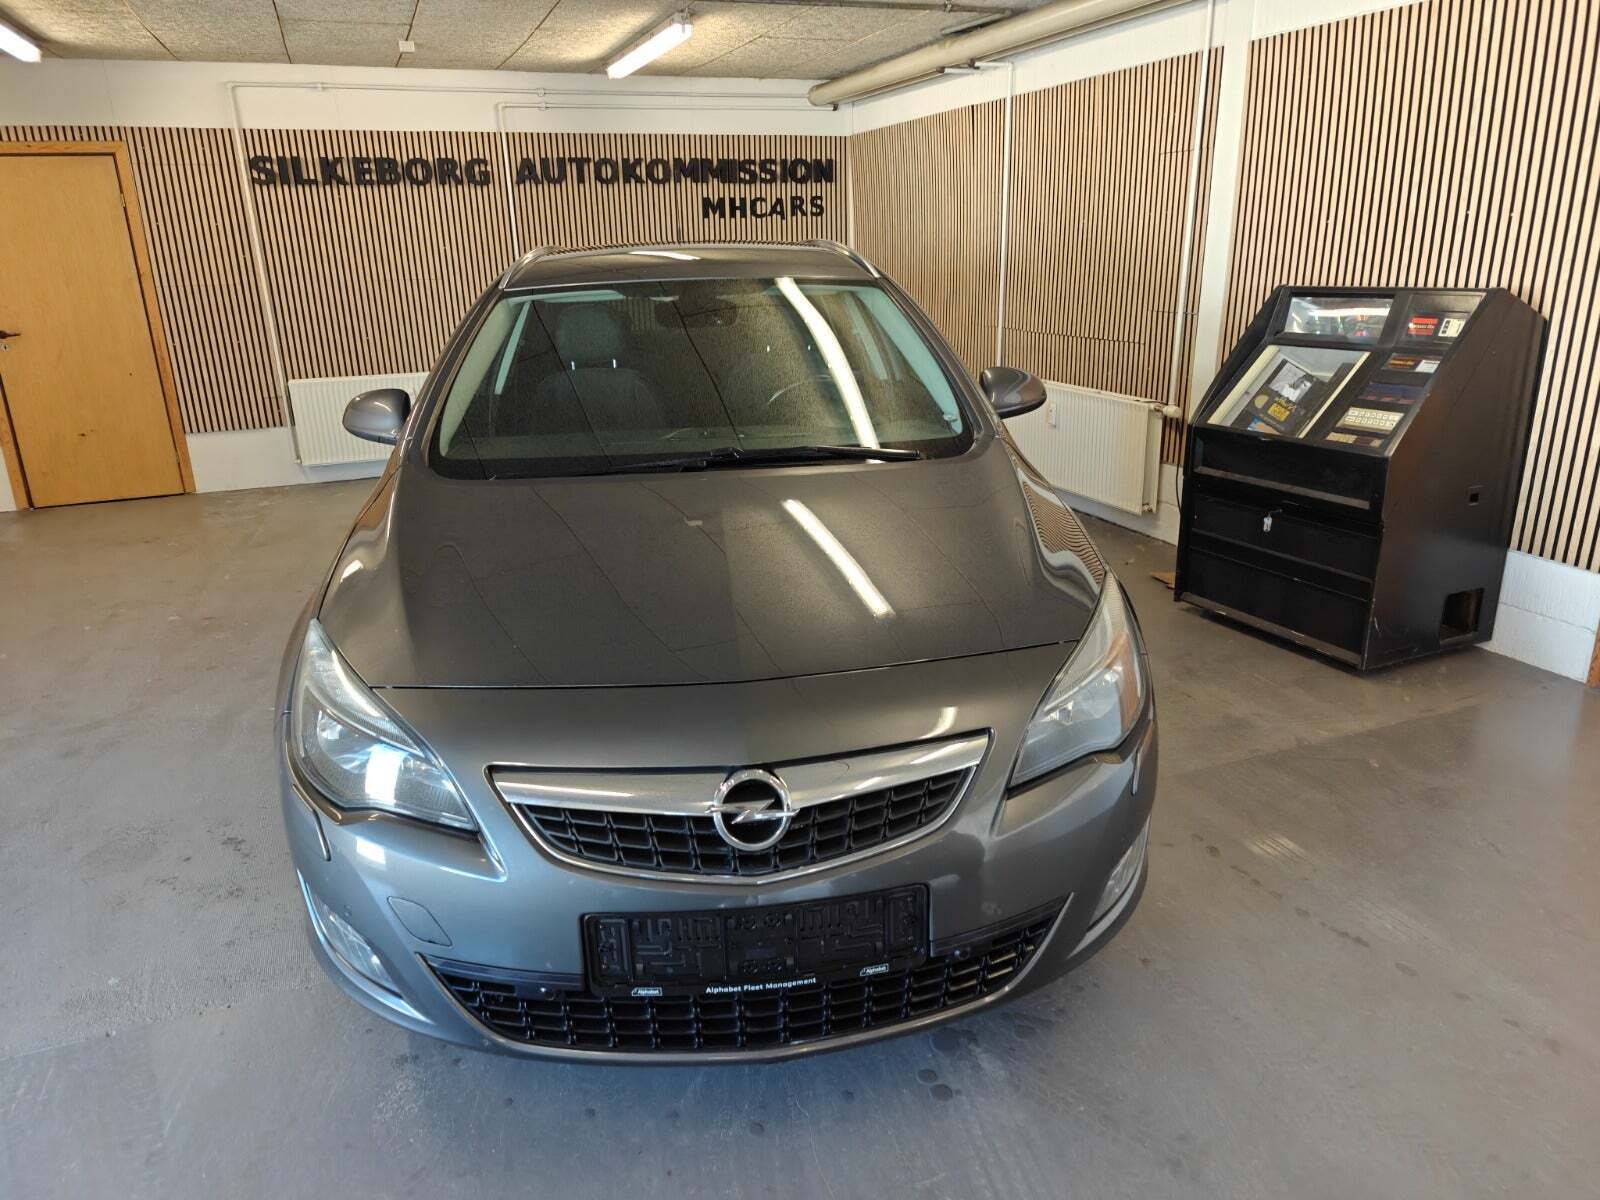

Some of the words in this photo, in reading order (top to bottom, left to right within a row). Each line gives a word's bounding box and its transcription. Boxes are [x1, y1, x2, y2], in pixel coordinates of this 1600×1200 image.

[250, 155, 491, 187] SILKEBORG
[515, 156, 834, 185] AUTOKOMMISSION
[703, 195, 825, 220] MHCARS
[705, 985, 742, 995] Alphabet
[743, 983, 763, 992] Fleet
[765, 977, 817, 989] Management
